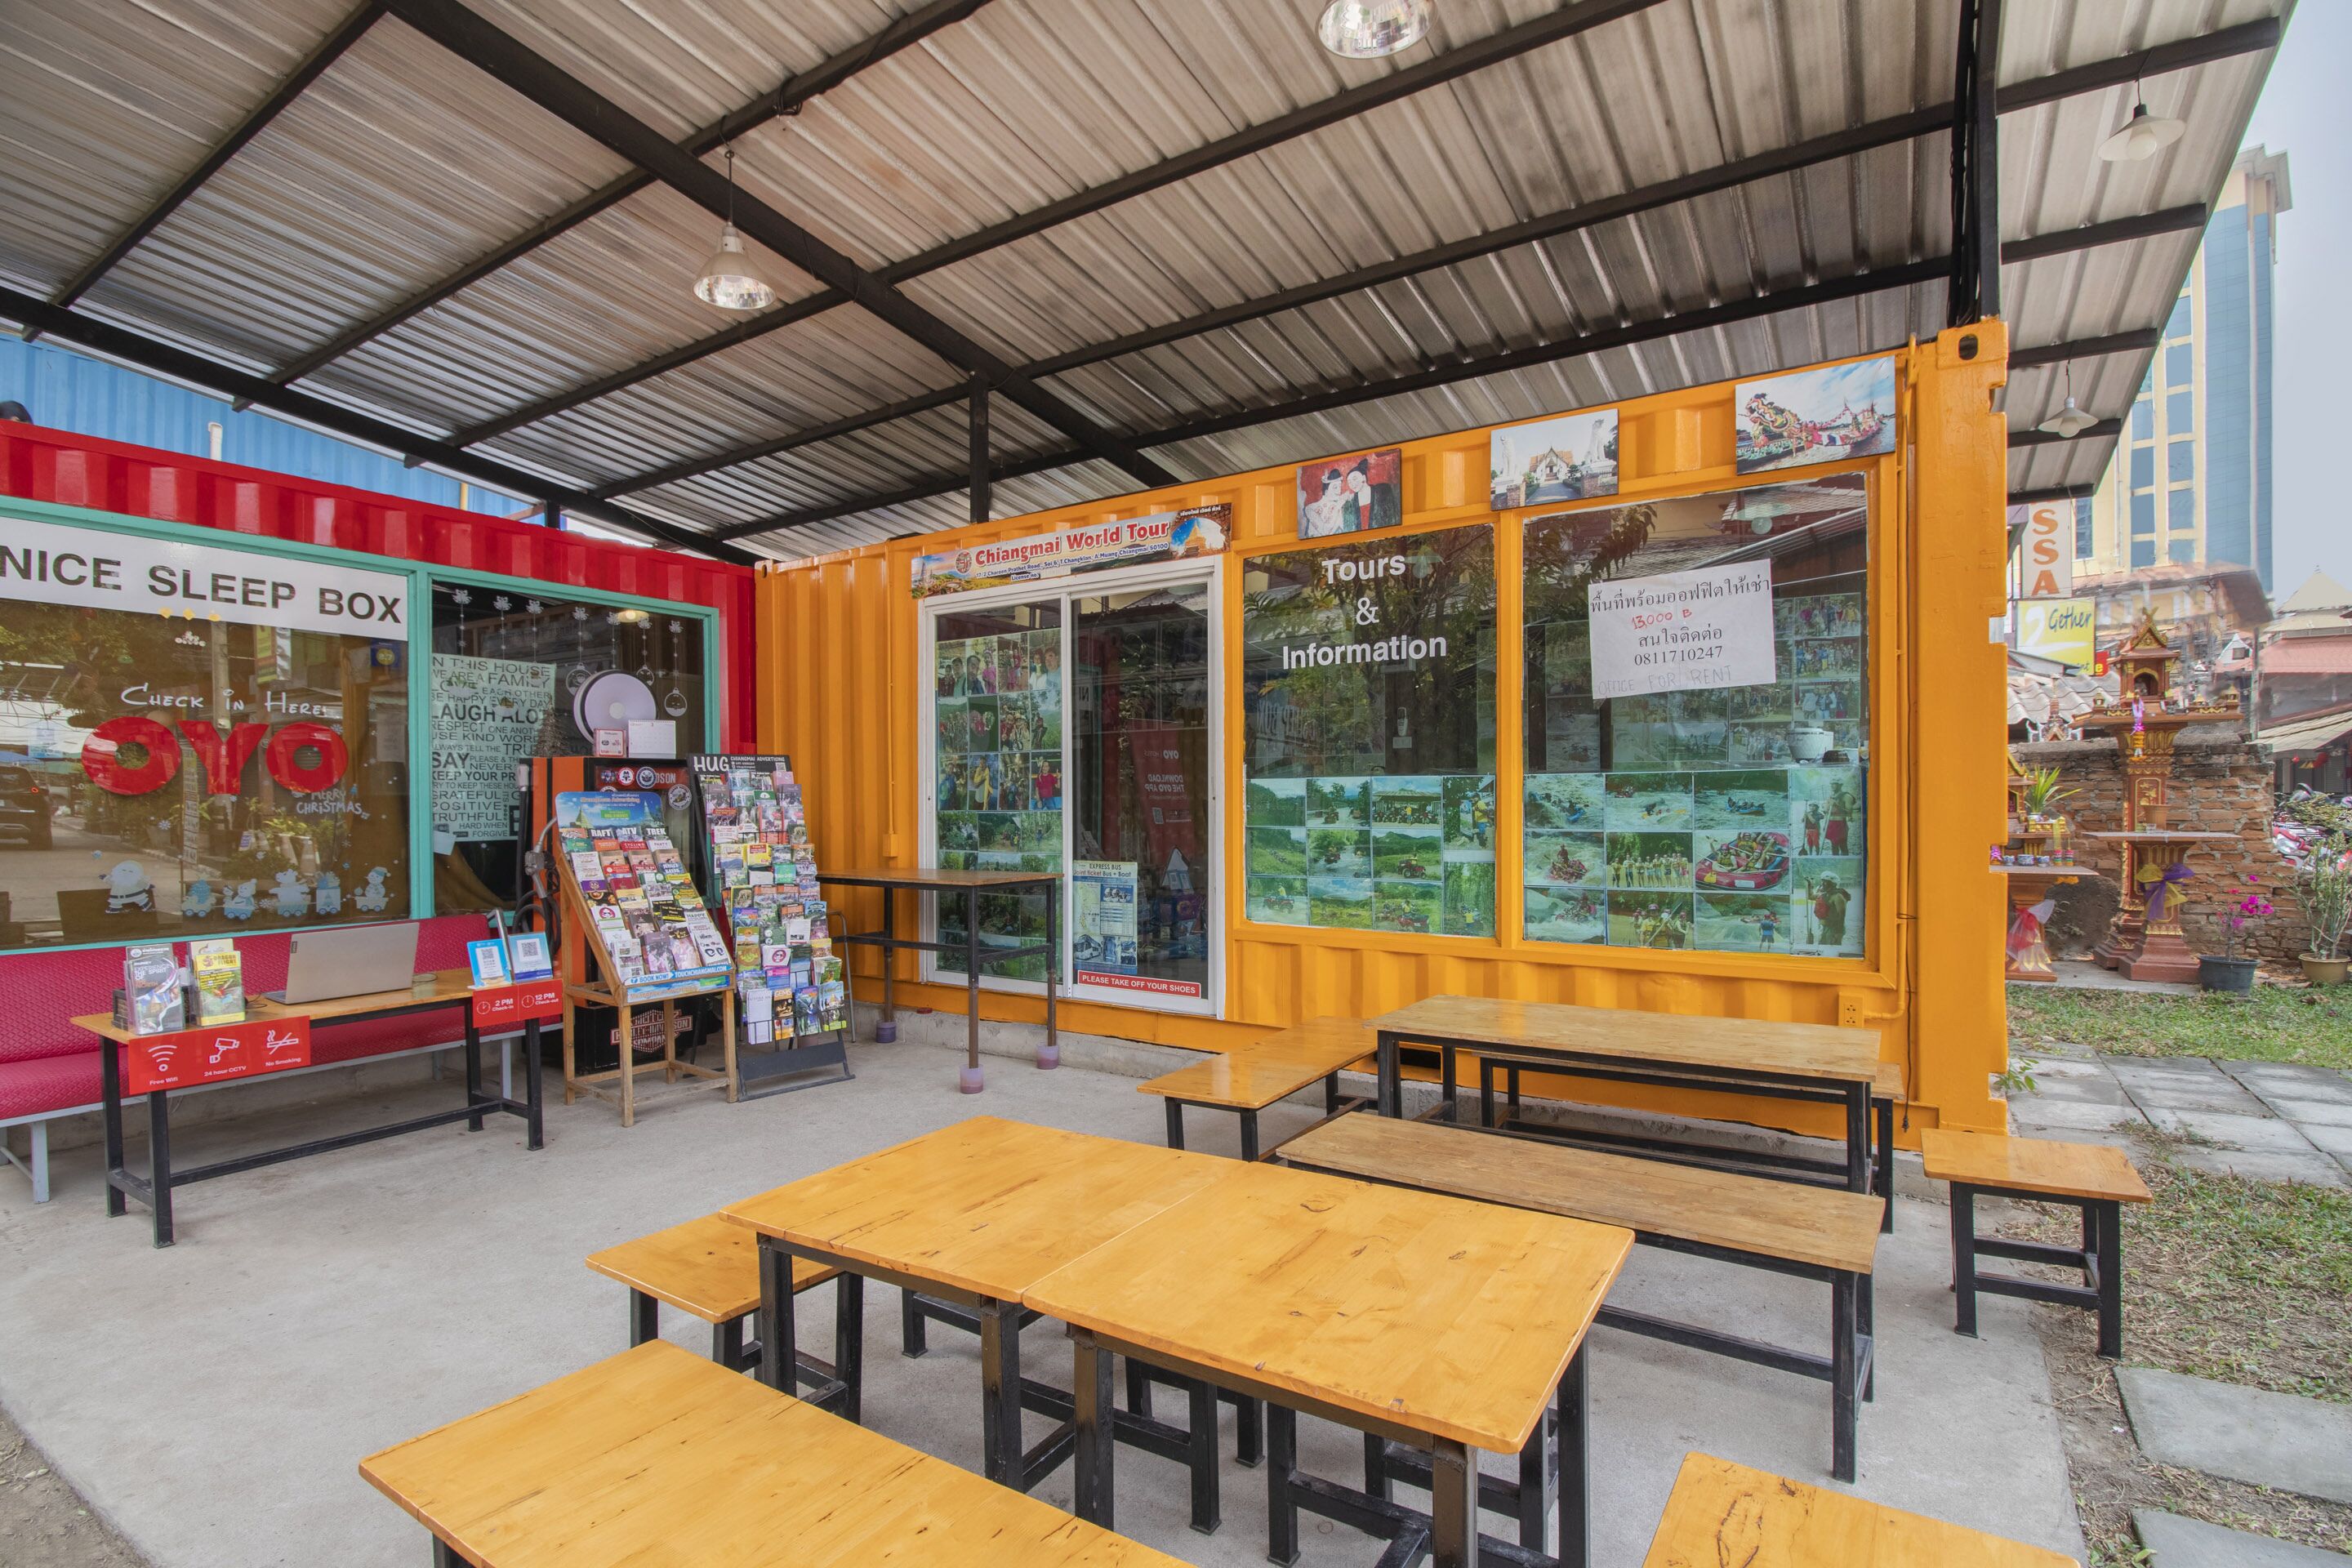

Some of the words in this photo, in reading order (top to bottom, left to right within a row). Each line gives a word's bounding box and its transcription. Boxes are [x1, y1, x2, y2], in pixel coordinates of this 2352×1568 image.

[975, 537, 1060, 566] Chiangmai
[1066, 526, 1120, 550] World
[1127, 521, 1169, 541] Tour
[987, 568, 1008, 577] Charoen
[1009, 565, 1027, 573] Prathet
[1119, 546, 1148, 557] Chiangmai
[1149, 542, 1169, 550] 50100
[1321, 555, 1406, 584] Tours
[0, 545, 122, 590] NICE
[149, 565, 296, 608] SLEEP
[318, 587, 401, 623] BOX
[1356, 597, 1379, 626] &
[2048, 606, 2091, 632] Gether
[1632, 612, 1673, 629] 13,000
[1639, 623, 1722, 648] สนใจติดต่อ
[1283, 635, 1447, 670] Information
[1634, 646, 1722, 666] 0811710247
[432, 656, 443, 666] N
[450, 658, 488, 670] THIS
[494, 662, 550, 676] HOUSE
[451, 670, 474, 681] ARE
[478, 673, 484, 683] A
[1648, 671, 1675, 691] FOR
[1691, 665, 1731, 685] RENT
[448, 695, 487, 704] HAPPY
[530, 700, 550, 709] DAY
[514, 689, 550, 699] OTHER
[432, 703, 496, 722] AUGH
[432, 721, 486, 733] RESPECT
[510, 725, 540, 733] ANOTH
[462, 733, 495, 742] KIND
[81, 716, 350, 795] OYO
[486, 745, 501, 753] THE
[432, 751, 470, 768] SAY
[470, 763, 512, 771] NEVER
[693, 756, 730, 772] HUG
[466, 771, 497, 782] YOUR
[432, 791, 501, 800] GRATEFUL
[432, 802, 501, 811] POSITIVE
[432, 812, 502, 822] TRUTHFUL
[591, 829, 611, 837] RAFT
[1082, 975, 1109, 984] PLEASE
[1111, 978, 1129, 987] TAKE
[1130, 980, 1145, 988] OFF
[1146, 982, 1168, 991] YOUR
[1169, 985, 1196, 994] SHOES
[501, 998, 514, 1006] PM
[229, 1065, 247, 1073] CCTV
[274, 1057, 301, 1067] Smoking
